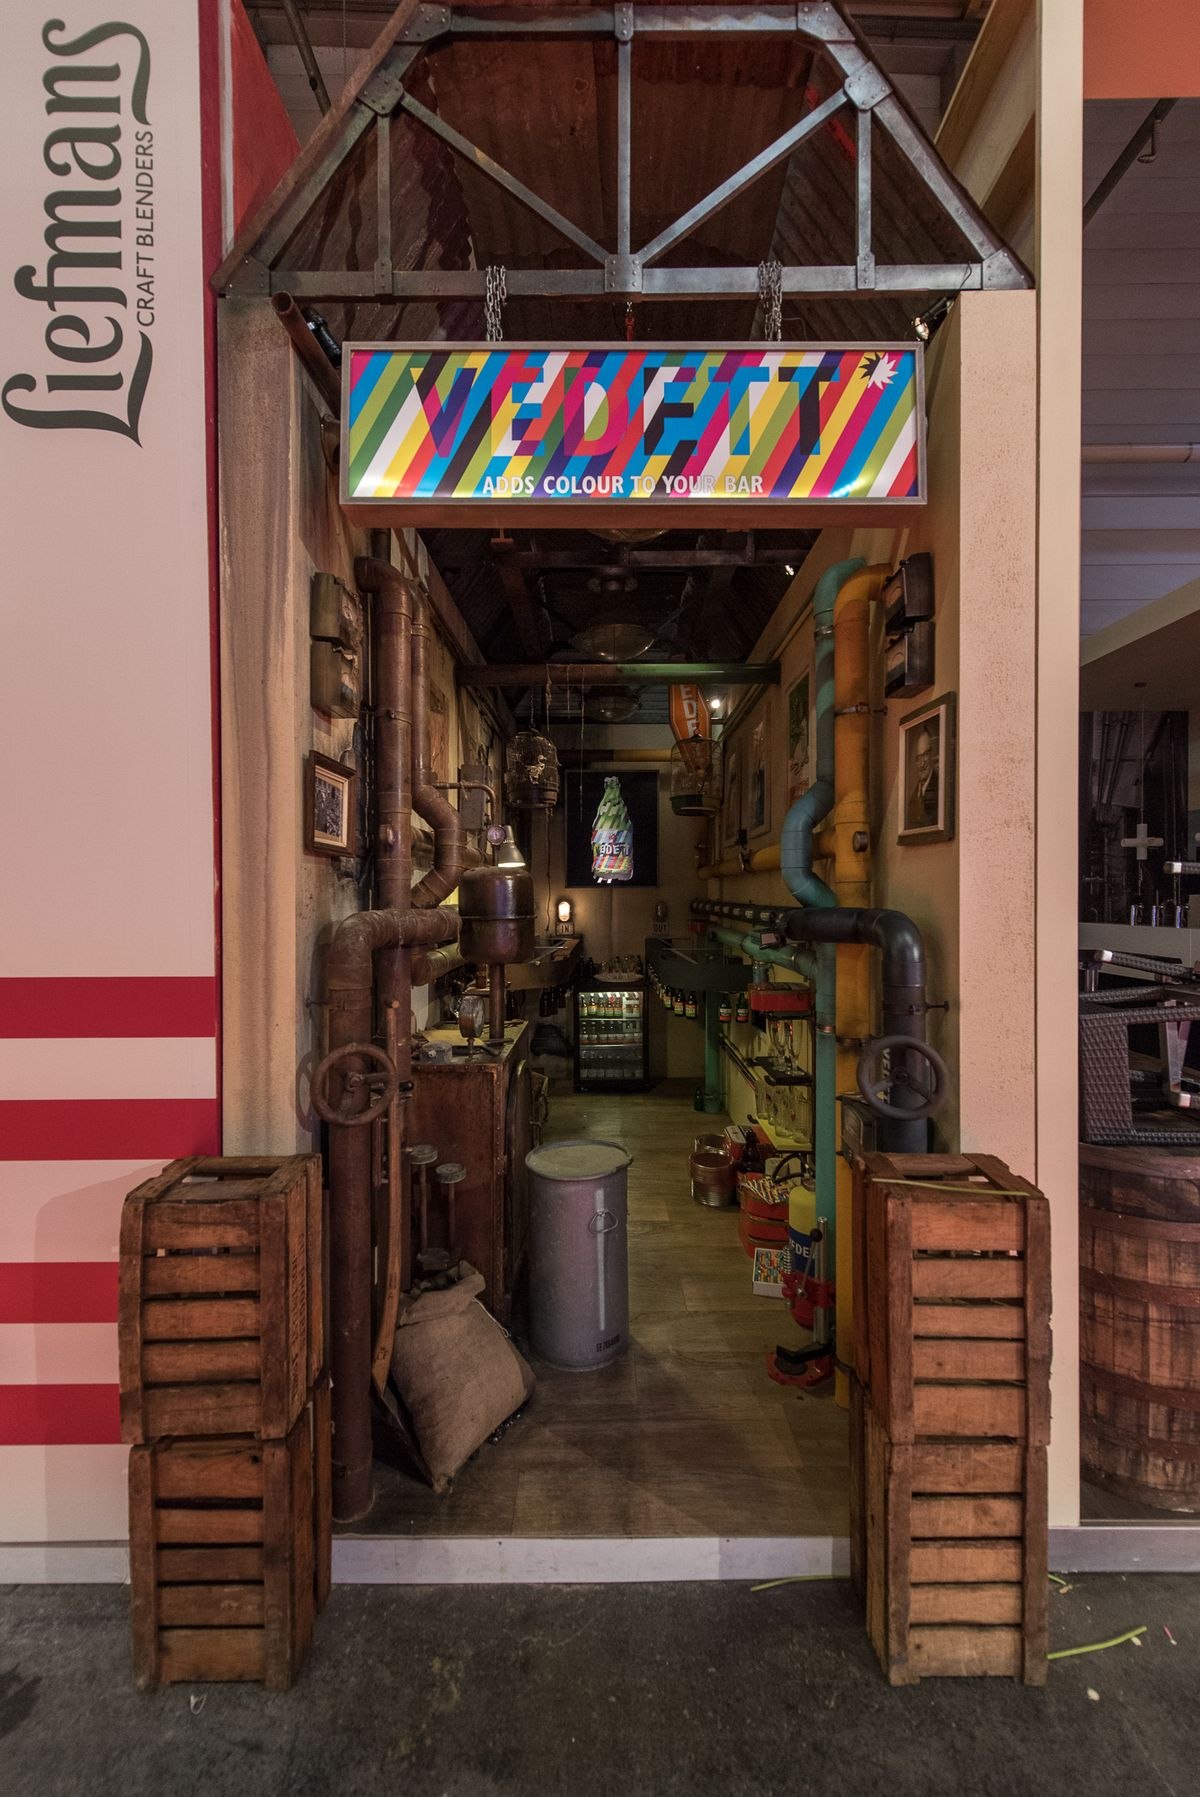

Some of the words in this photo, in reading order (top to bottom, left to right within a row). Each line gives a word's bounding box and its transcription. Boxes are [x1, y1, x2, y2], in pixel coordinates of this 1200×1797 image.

[1, 18, 153, 448] Liefmans
[134, 131, 154, 248] BLENDERS
[135, 251, 154, 327] CRAFT
[409, 366, 840, 458] VEDETT
[482, 475, 535, 494] ADDS
[543, 475, 624, 494] COLOUR
[630, 475, 656, 494] TO
[662, 475, 715, 494] YOUR
[725, 475, 764, 494] BAR
